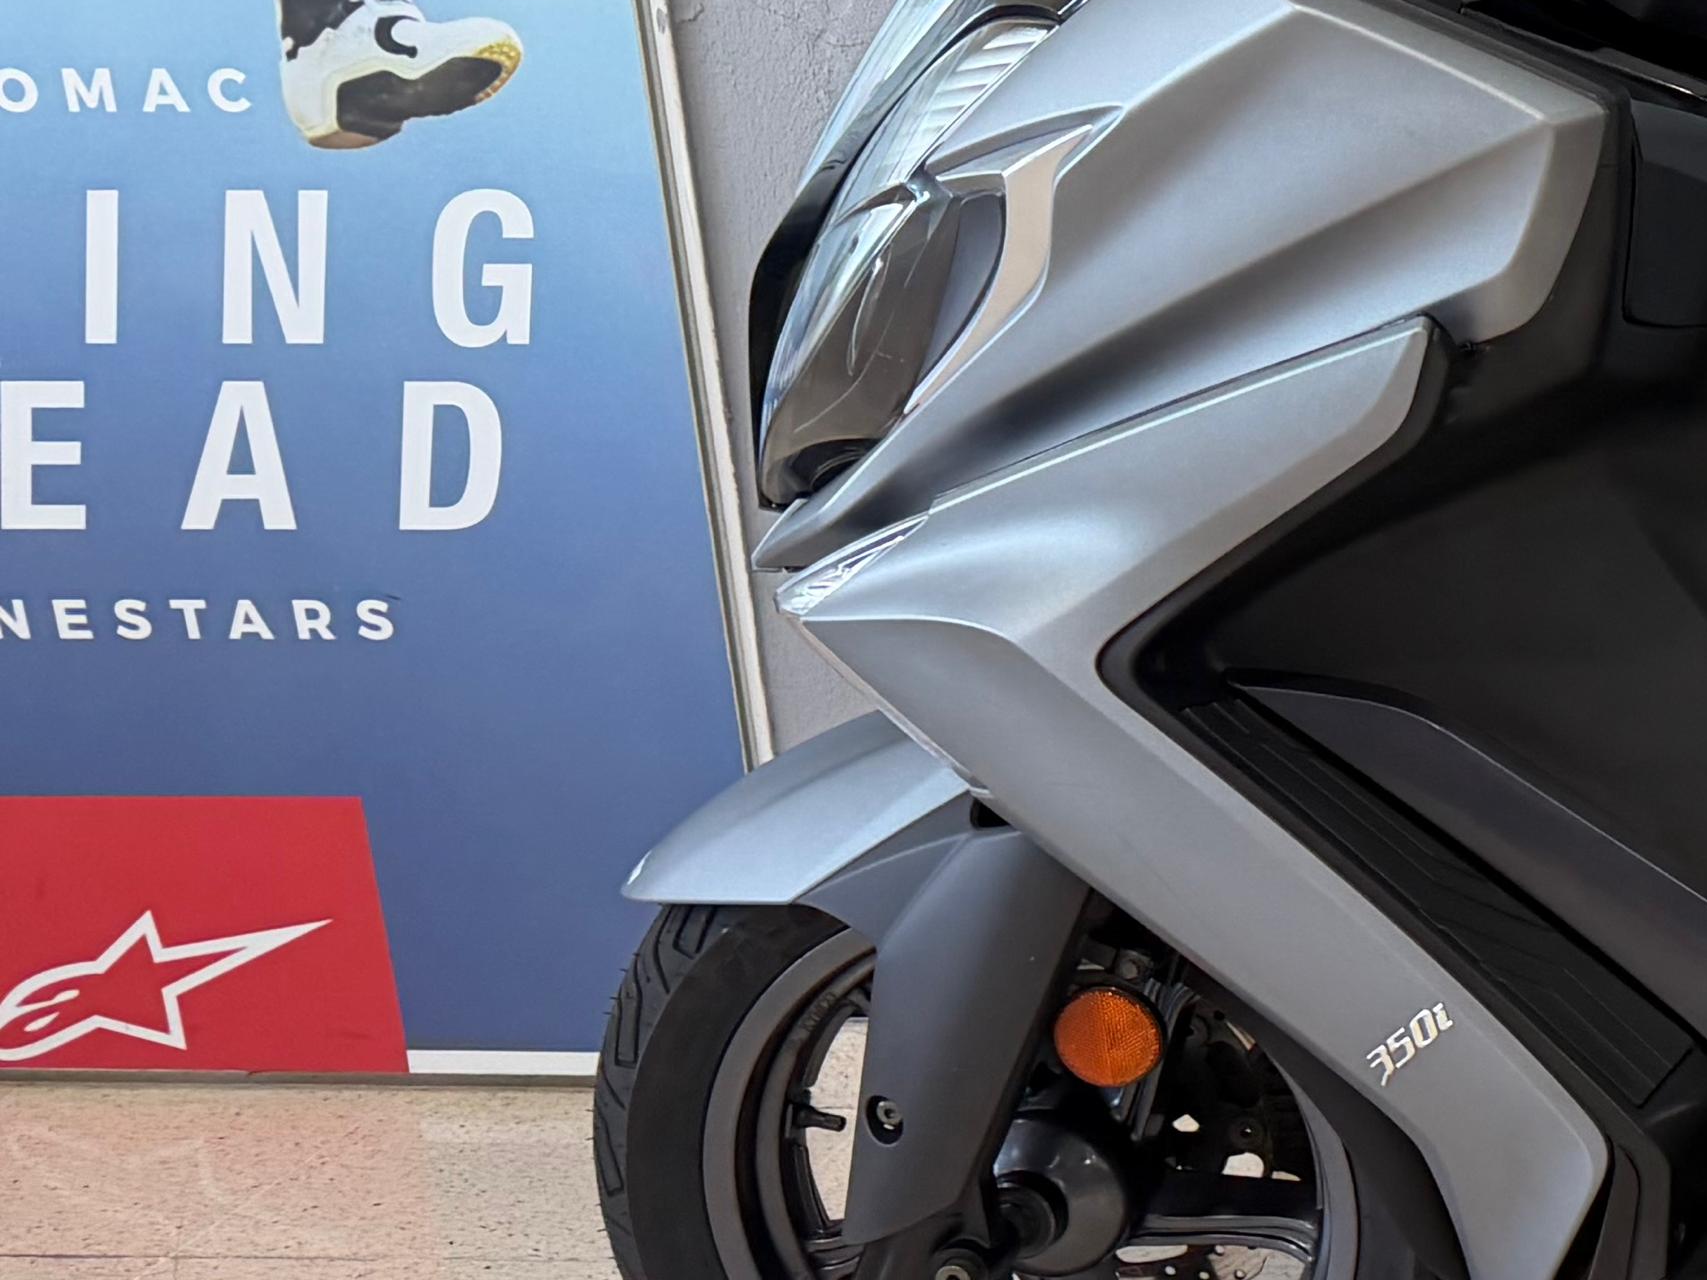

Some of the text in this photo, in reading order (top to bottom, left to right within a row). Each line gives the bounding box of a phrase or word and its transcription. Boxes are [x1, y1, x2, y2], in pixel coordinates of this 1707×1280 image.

[0, 67, 253, 113] OMAC
[85, 188, 534, 348] ING
[0, 380, 502, 531] EAD
